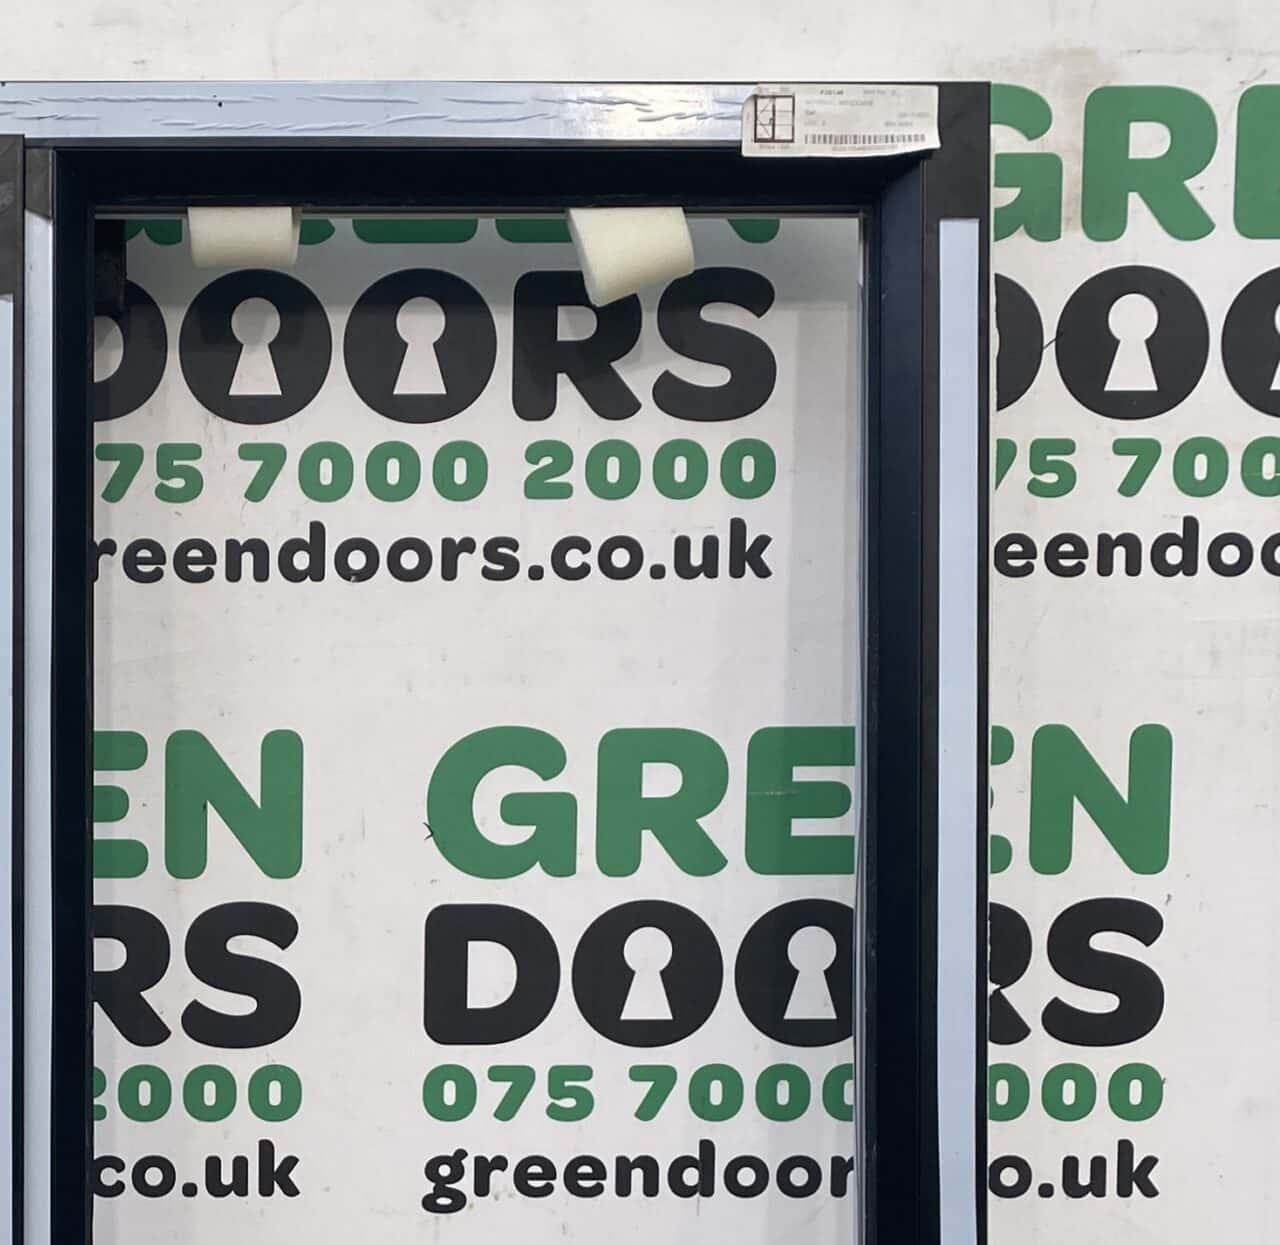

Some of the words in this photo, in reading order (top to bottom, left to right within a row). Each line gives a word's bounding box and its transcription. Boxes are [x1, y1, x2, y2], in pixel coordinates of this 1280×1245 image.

[238, 441, 488, 503] 7000
[523, 439, 777, 501] 2000
[422, 1063, 595, 1123] 075
